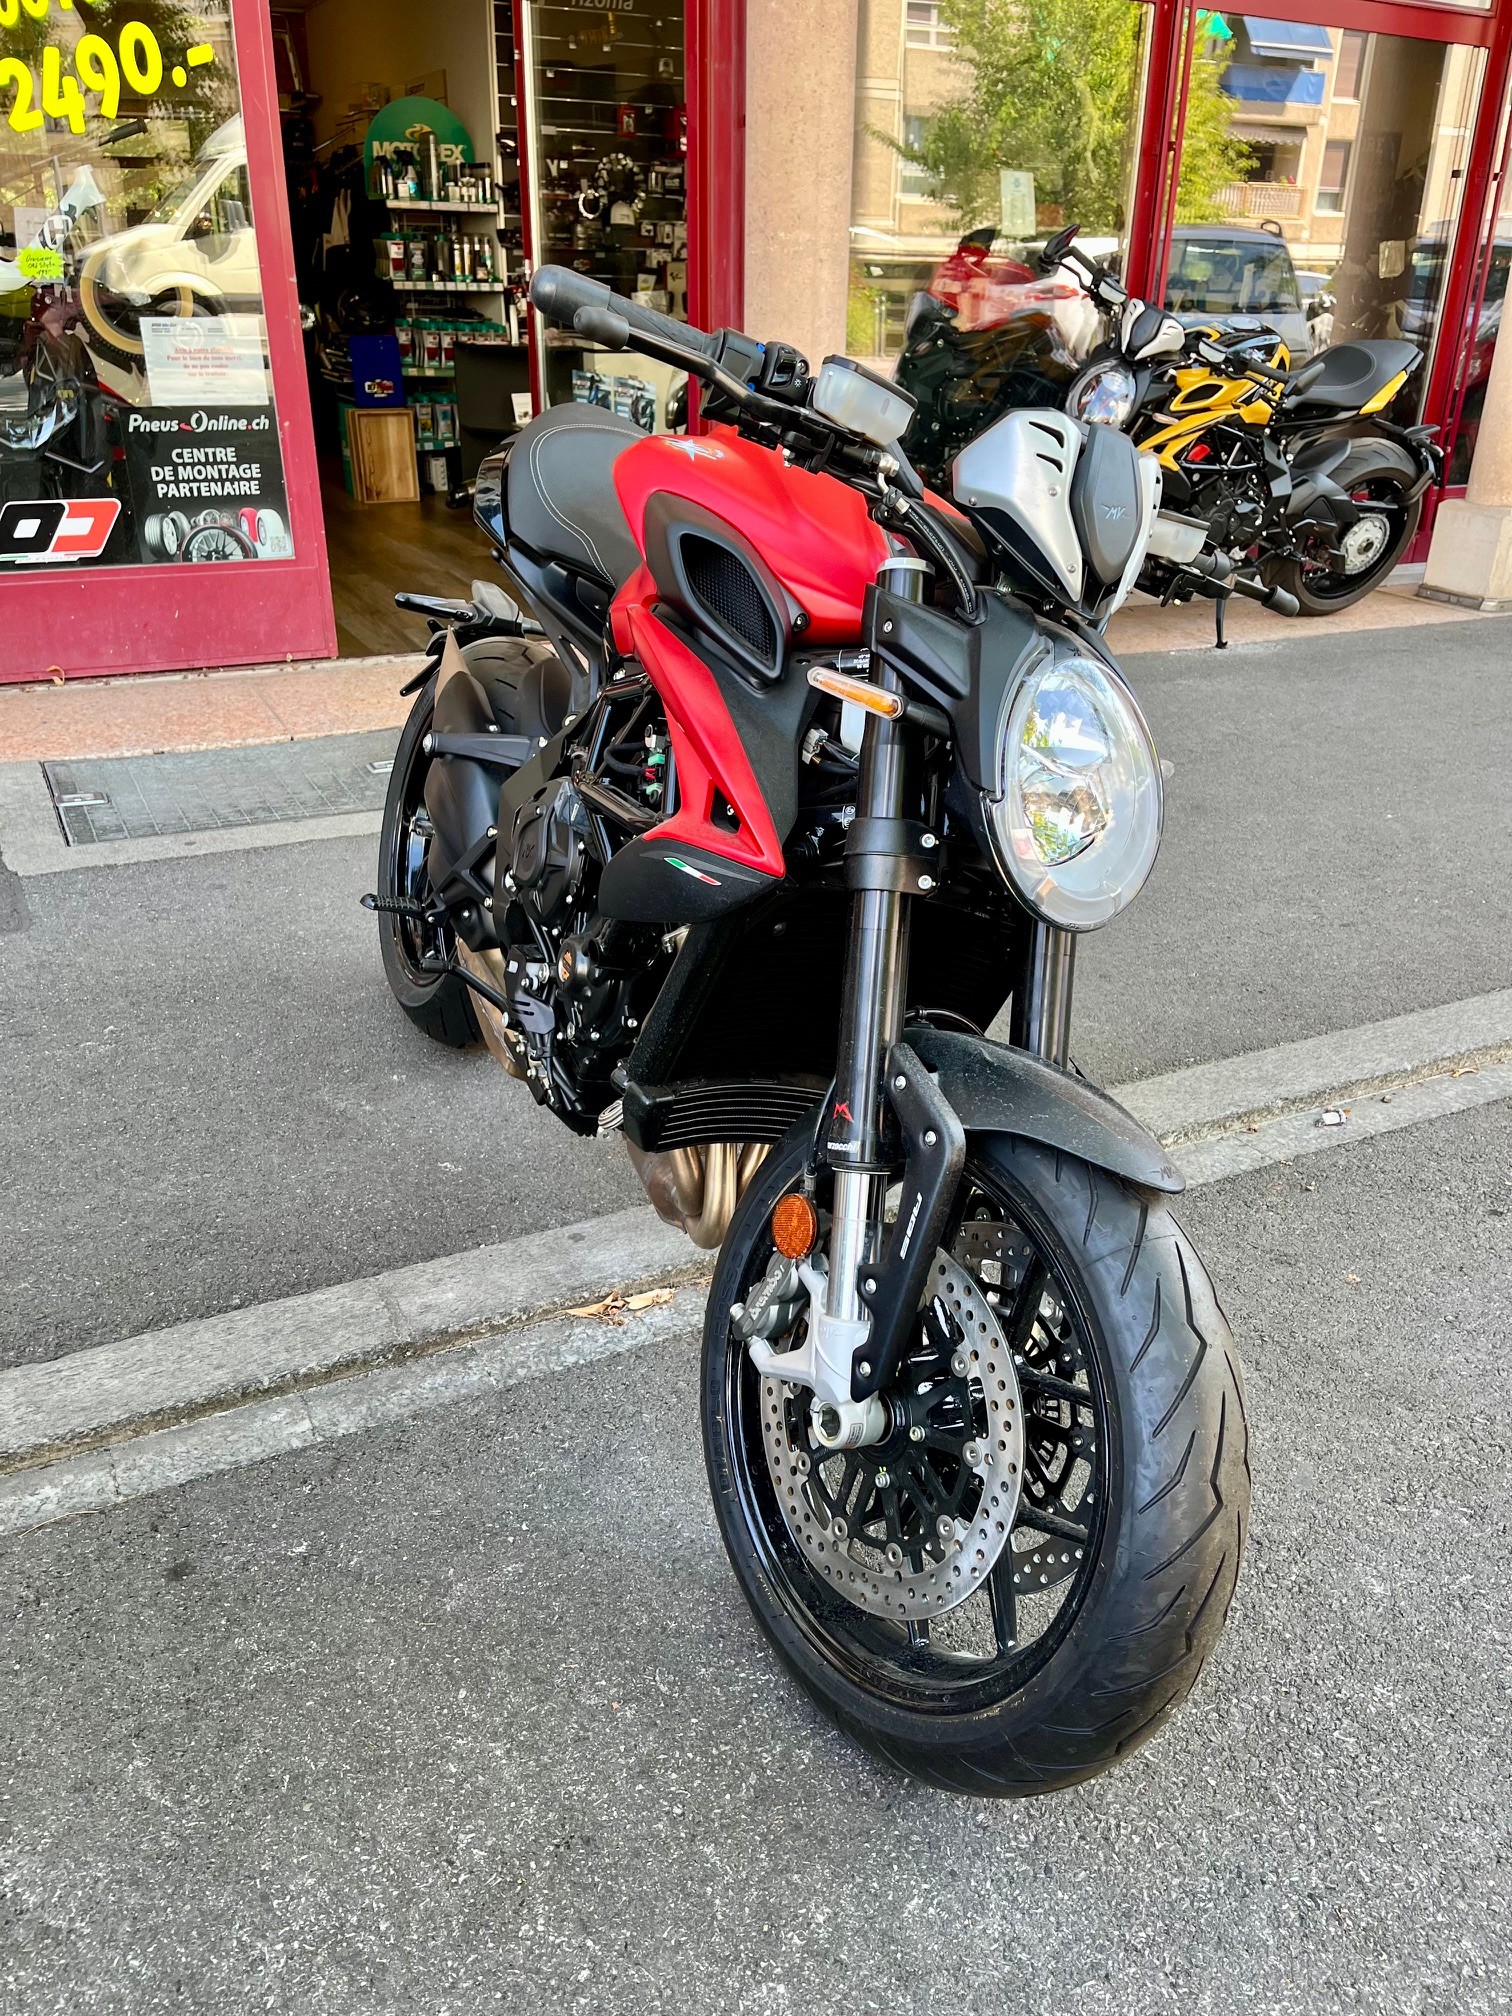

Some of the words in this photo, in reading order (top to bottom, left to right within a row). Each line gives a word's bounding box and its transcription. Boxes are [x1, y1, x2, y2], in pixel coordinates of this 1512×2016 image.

[171, 447, 237, 463] CENTRE
[150, 466, 175, 481] DE
[177, 463, 261, 480] MONTAGE
[157, 480, 260, 498] PARTENAIRE
